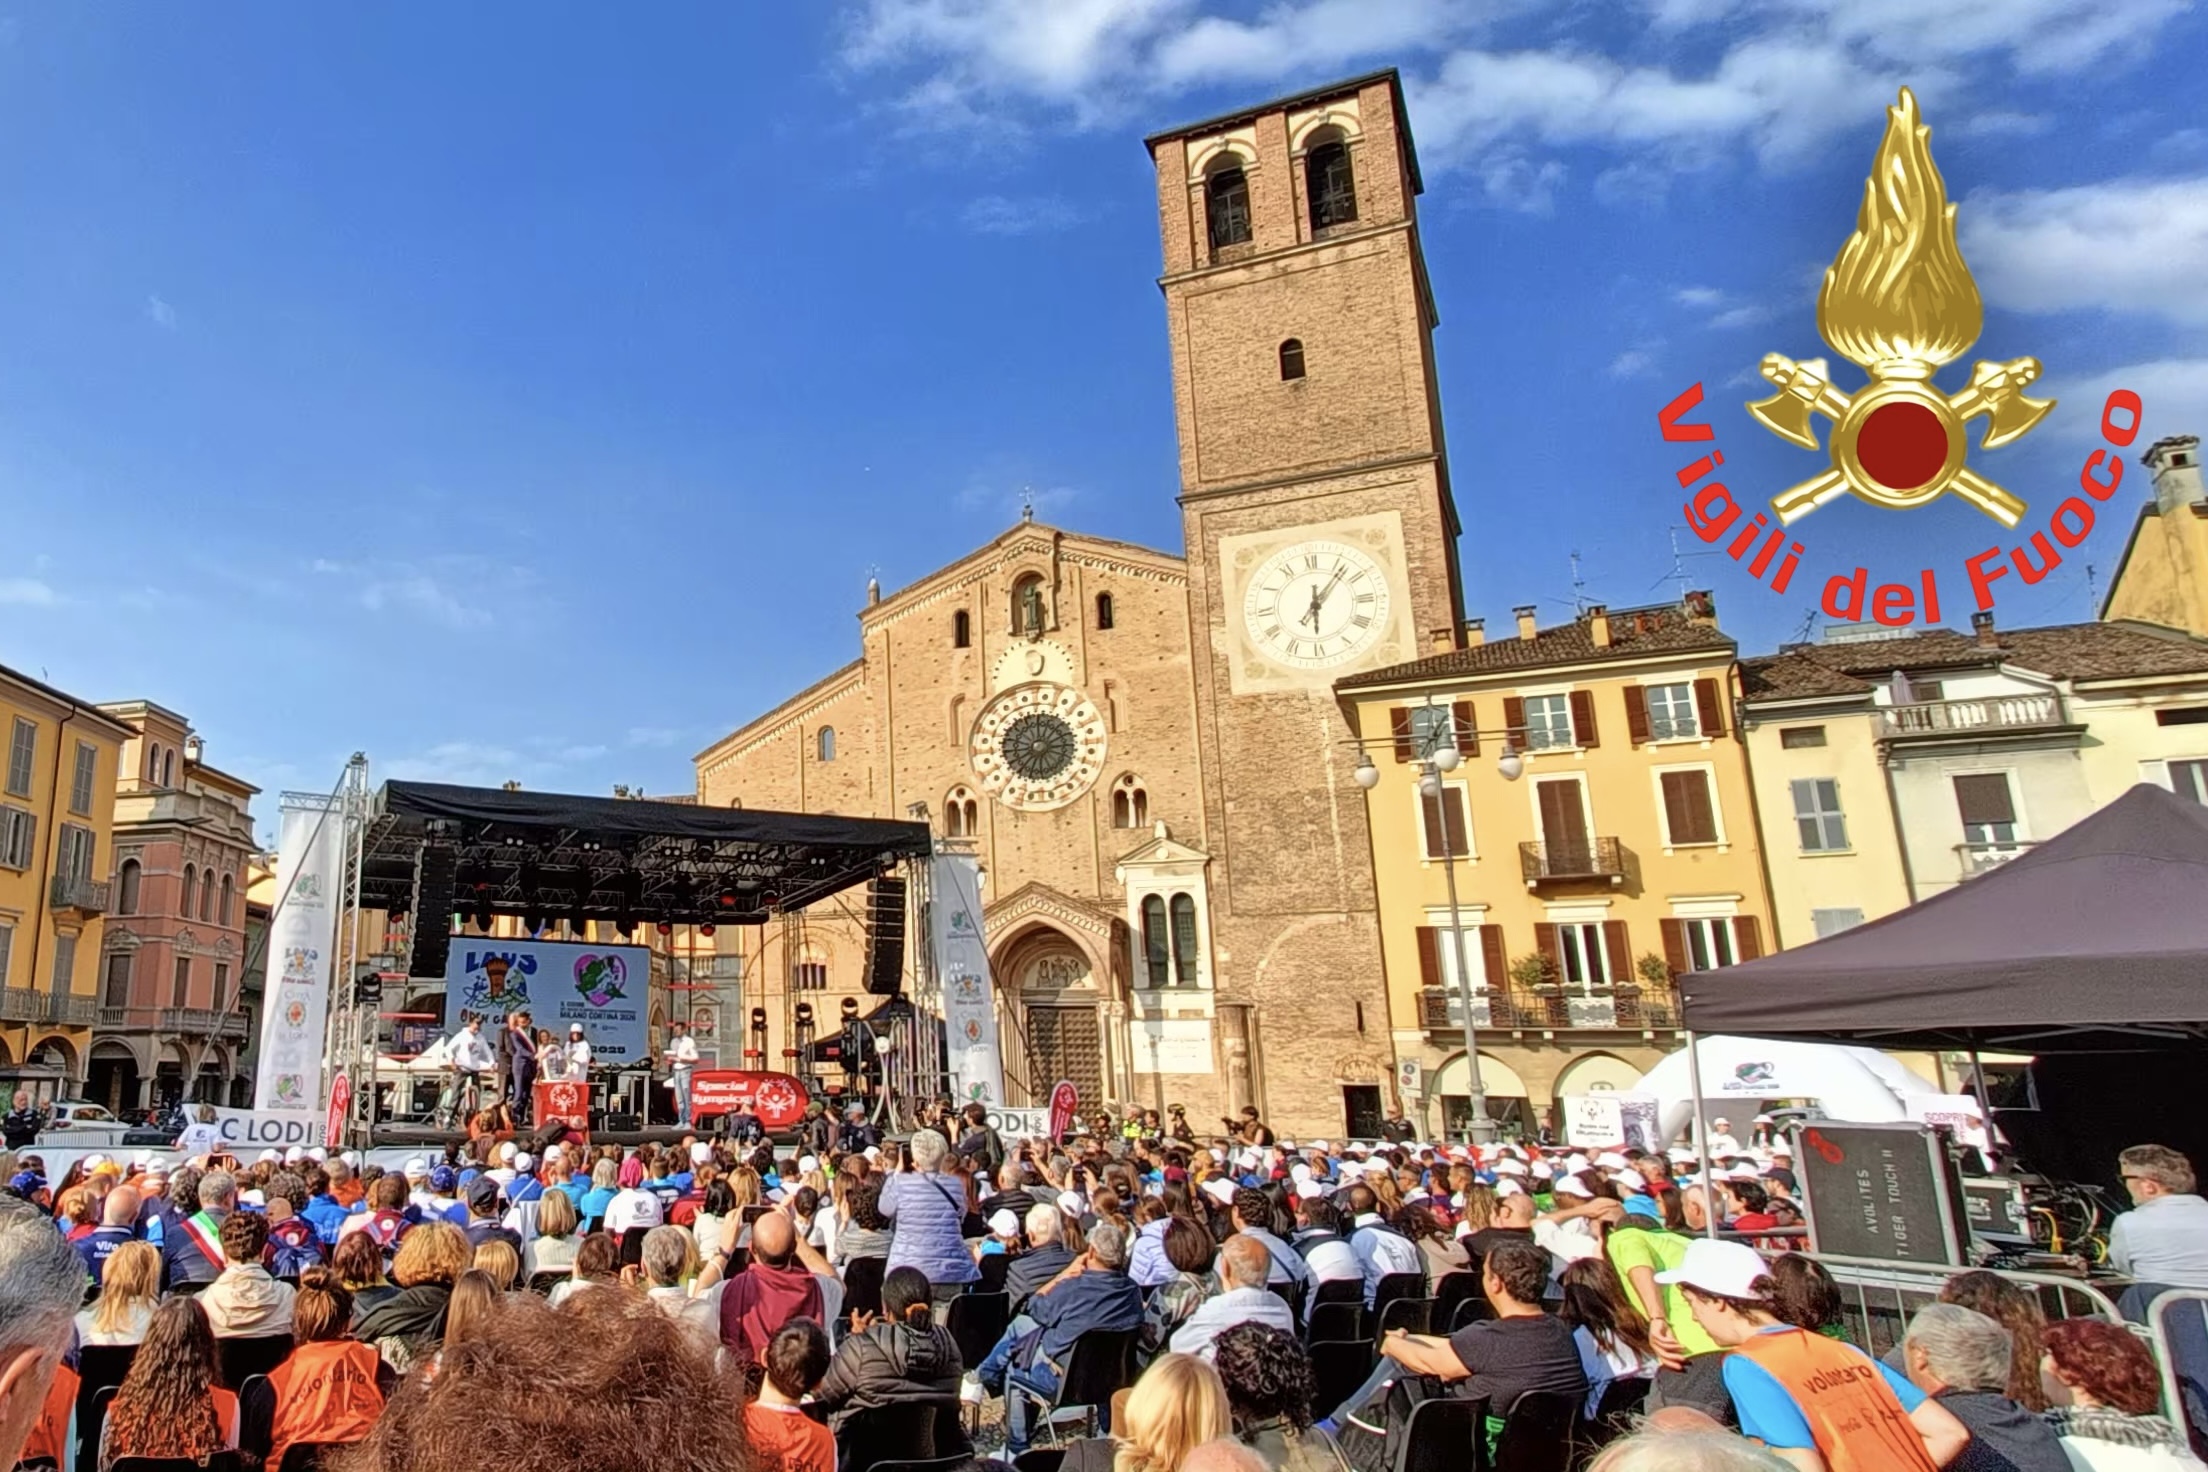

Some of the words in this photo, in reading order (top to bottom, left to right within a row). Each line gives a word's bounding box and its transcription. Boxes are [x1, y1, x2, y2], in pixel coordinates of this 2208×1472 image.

[465, 951, 538, 975] LAUS
[560, 1011, 587, 1019] MILANO
[588, 1012, 618, 1020] CORTINA
[696, 1080, 749, 1093] Special
[691, 1093, 755, 1106] lympics
[247, 1119, 313, 1144] LODI
[986, 1112, 1028, 1133] ODI
[1883, 1163, 1902, 1204] TOUCH
[1856, 1168, 1879, 1234] AVOLITES
[1891, 1214, 1910, 1257] TIGER
